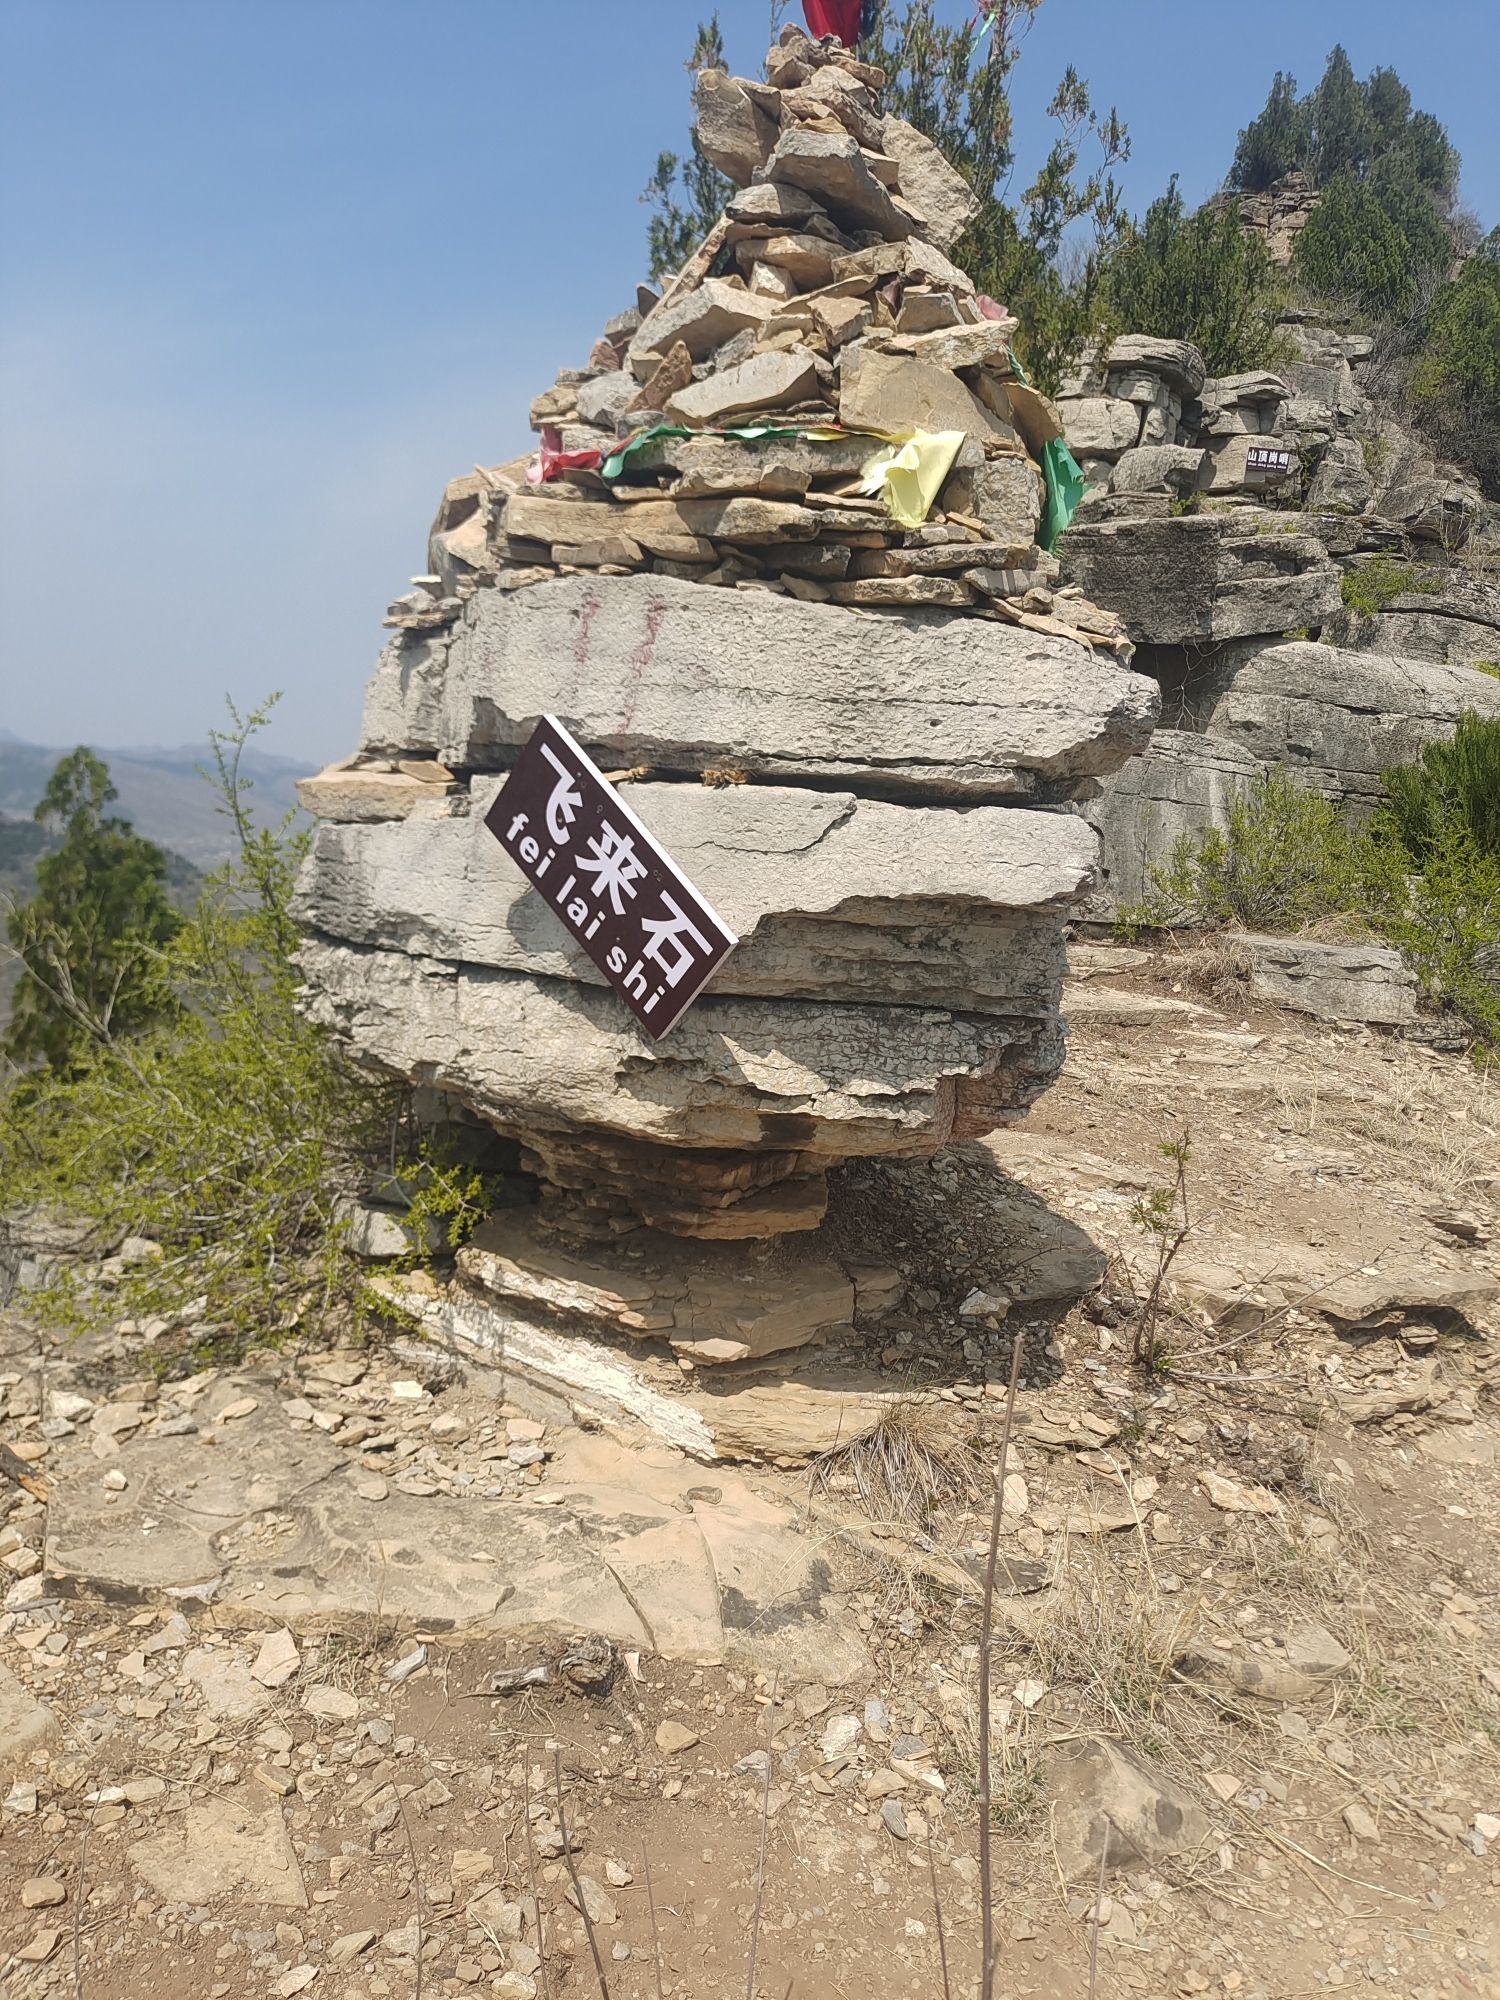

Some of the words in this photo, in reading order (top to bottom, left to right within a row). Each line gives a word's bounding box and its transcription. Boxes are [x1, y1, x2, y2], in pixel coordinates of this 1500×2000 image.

[506, 813, 556, 879] fei
[555, 874, 606, 941] lai
[606, 945, 666, 1014] shi
[540, 743, 714, 989] 飞来石
